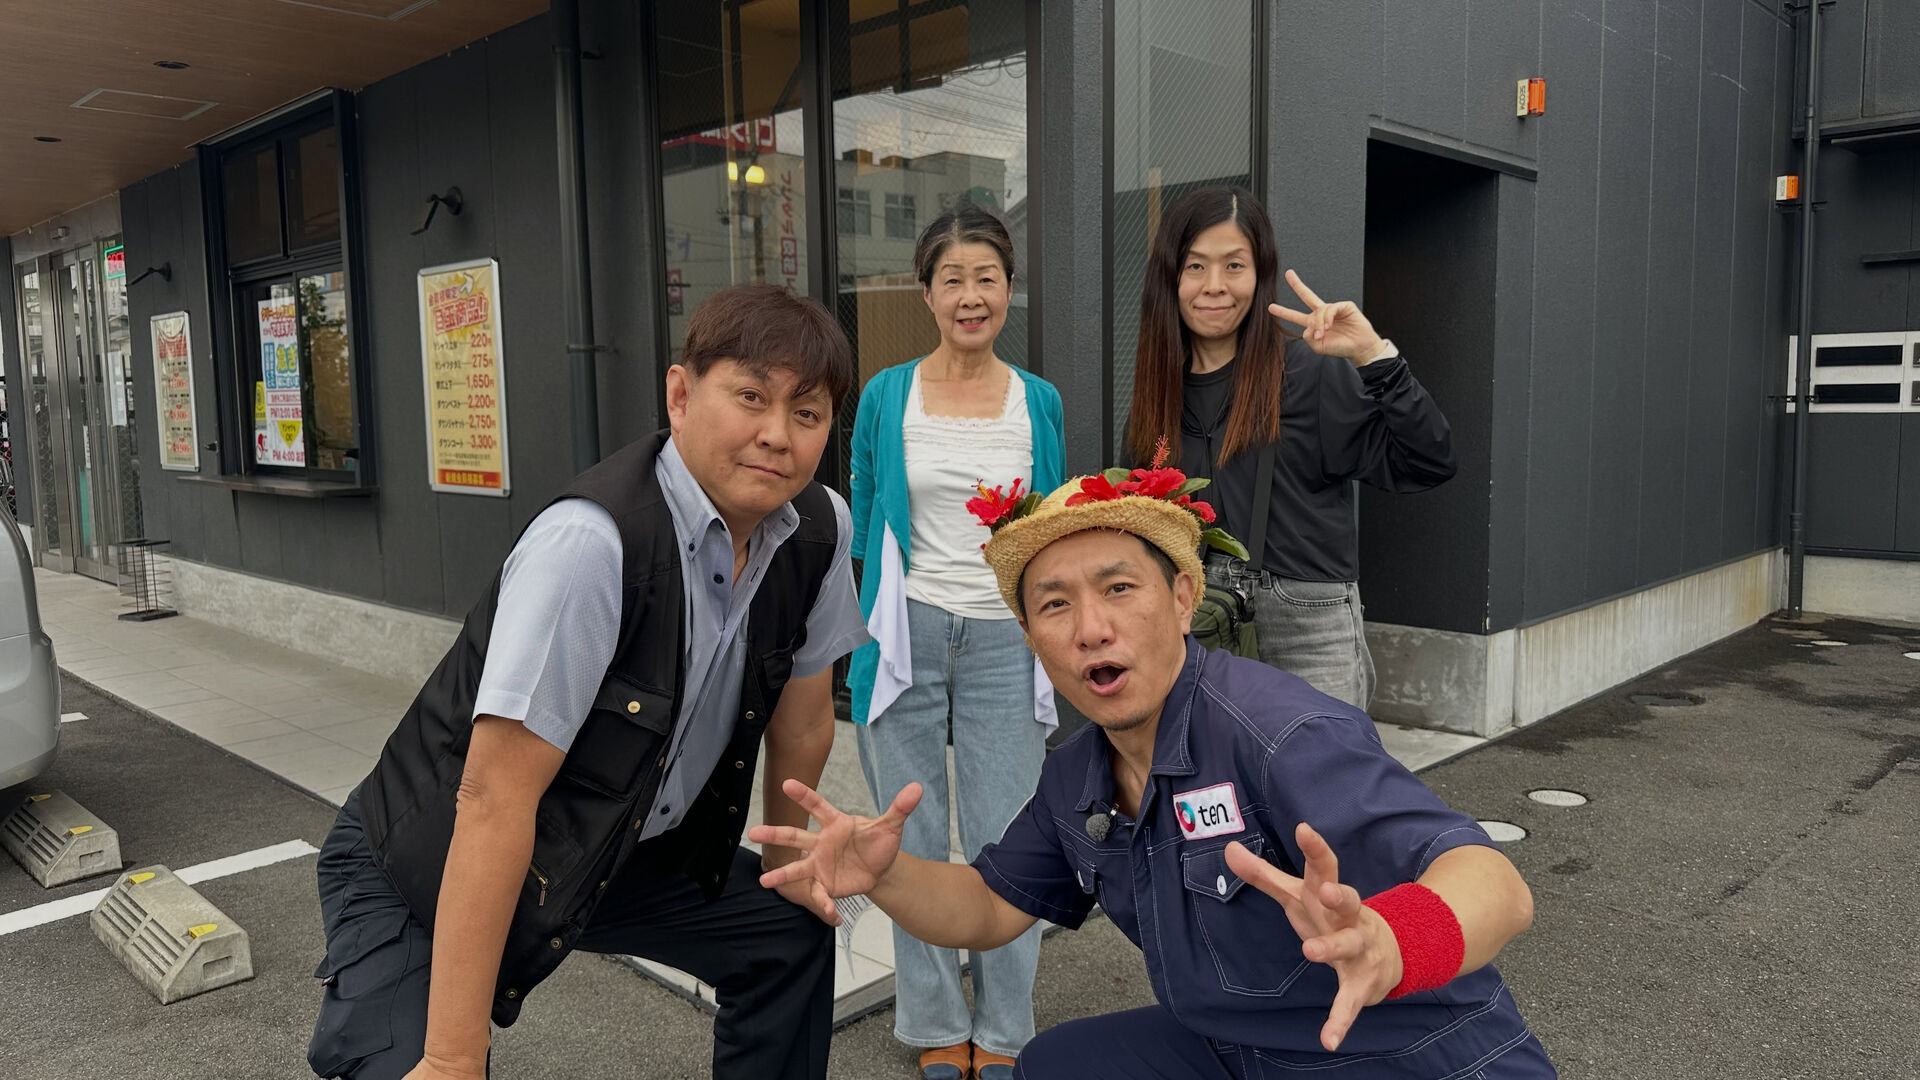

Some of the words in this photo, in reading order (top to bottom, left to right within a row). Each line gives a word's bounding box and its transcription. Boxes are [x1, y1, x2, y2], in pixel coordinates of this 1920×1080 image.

[471, 332, 492, 348] 220円
[472, 353, 493, 369] 275円
[466, 374, 494, 390] 1,650円
[437, 400, 461, 409] ダウンベスト
[468, 394, 495, 410] 2,200円
[468, 414, 496, 430] 2,750円
[439, 438, 464, 448] ダウンコート
[471, 434, 497, 449] 3,300円
